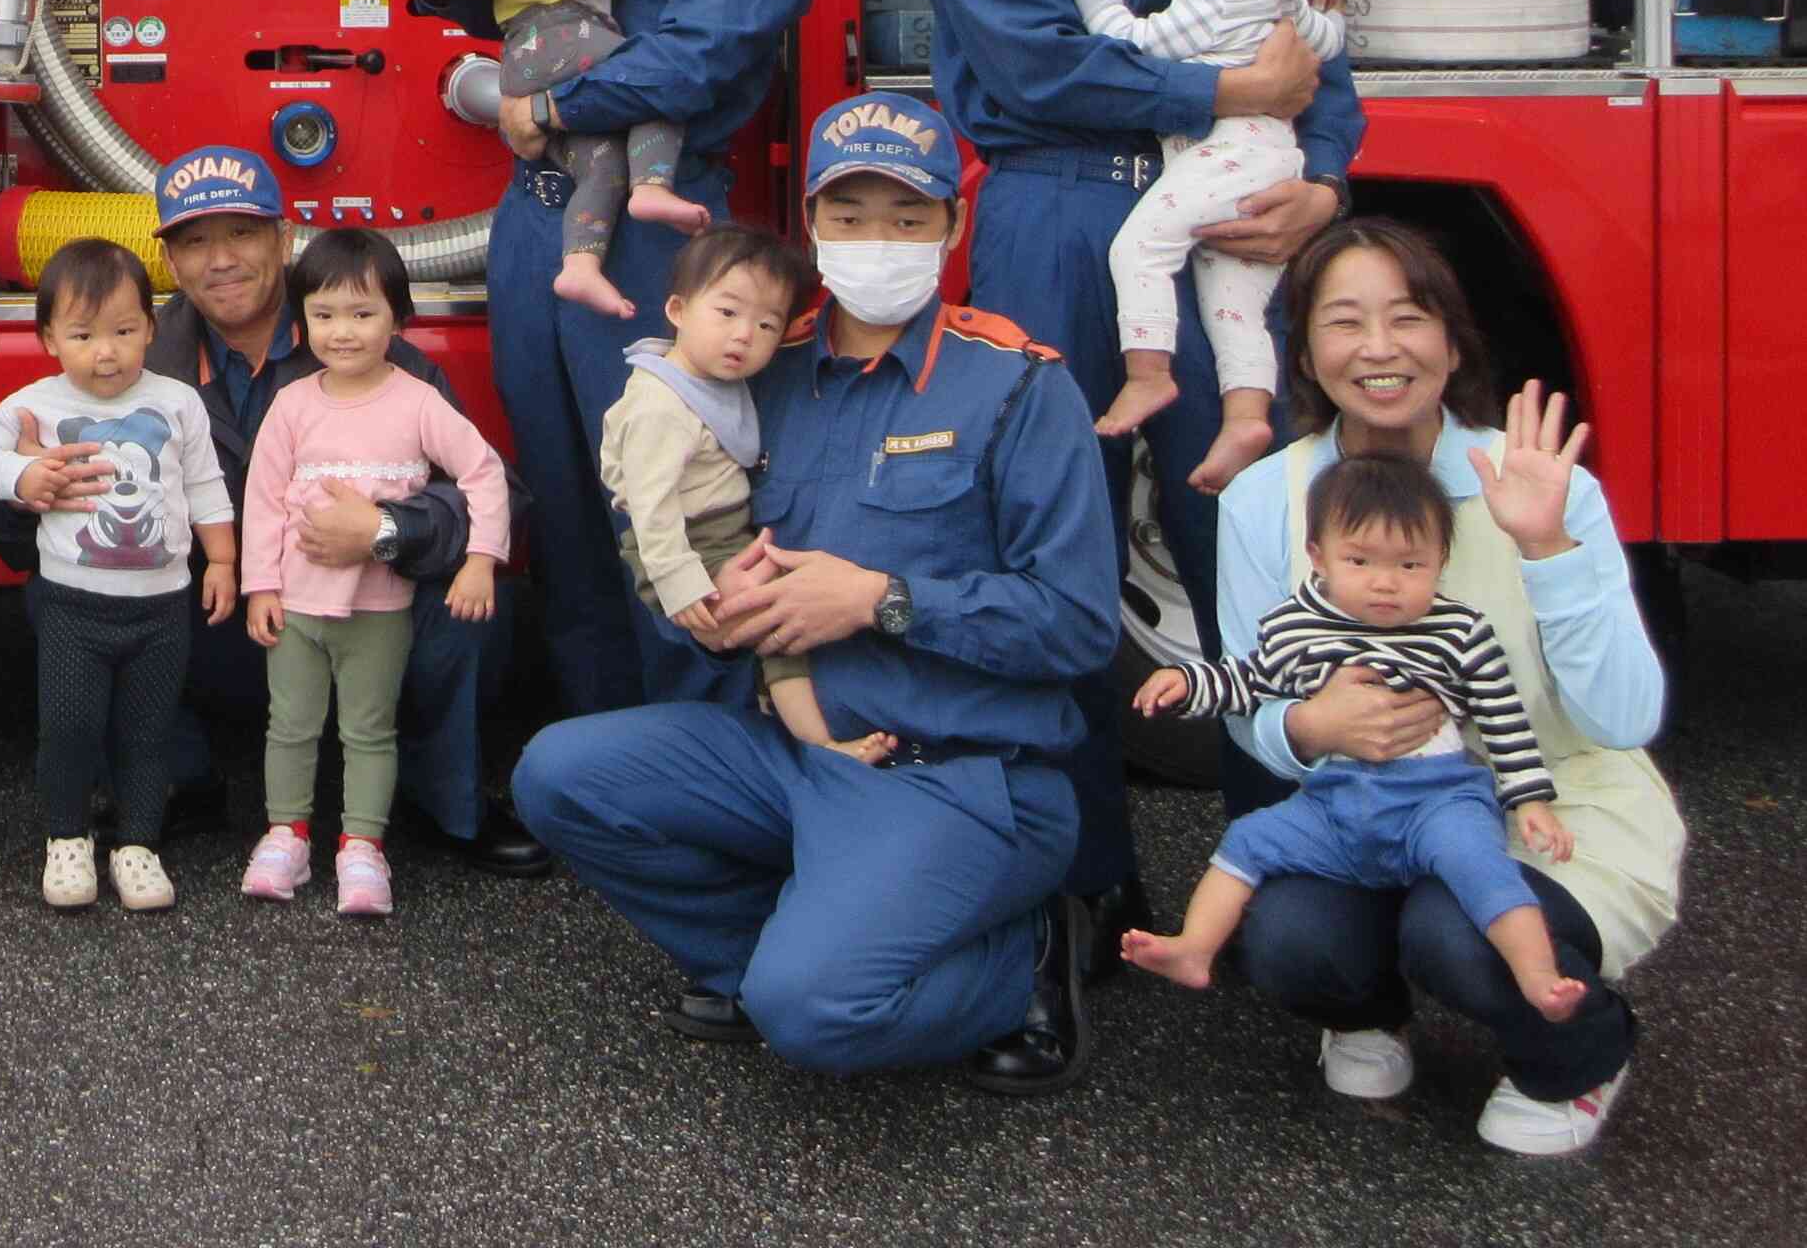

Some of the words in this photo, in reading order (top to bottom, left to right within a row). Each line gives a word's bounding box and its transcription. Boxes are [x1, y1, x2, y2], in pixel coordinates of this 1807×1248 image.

[822, 103, 937, 156] TOYAMA
[842, 142, 872, 155] FIRE
[875, 143, 915, 158] DEPT.
[163, 157, 257, 200] TOYAMA
[184, 193, 208, 206] FIRE
[210, 188, 242, 200] DEPT.
